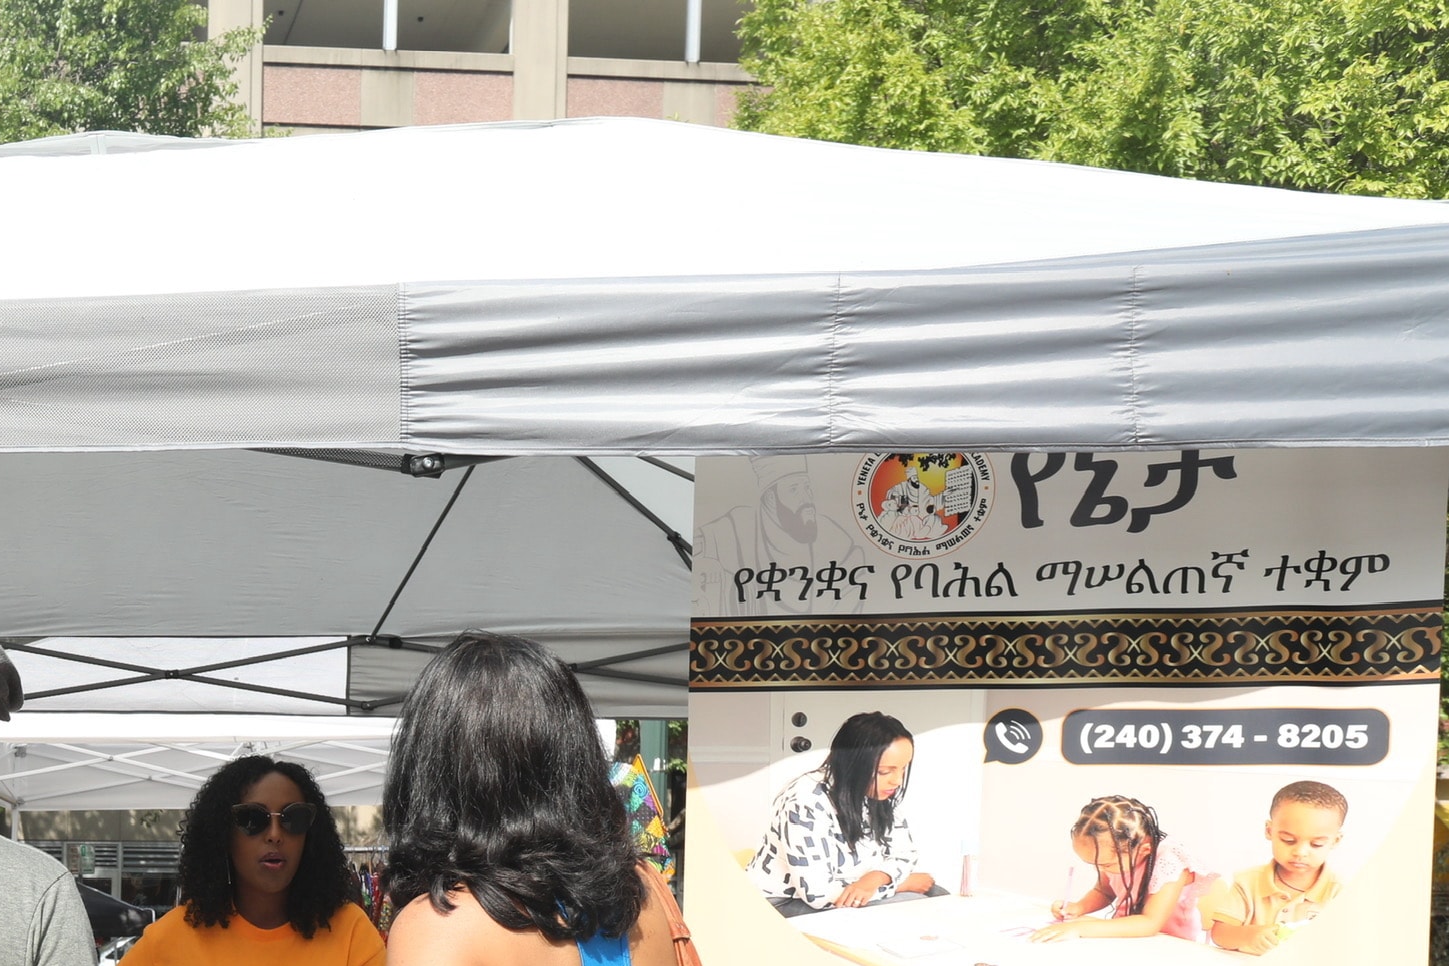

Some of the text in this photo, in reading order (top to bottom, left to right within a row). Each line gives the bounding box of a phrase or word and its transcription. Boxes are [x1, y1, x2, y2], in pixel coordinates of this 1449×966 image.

[857, 457, 876, 486] YENETA
[1010, 449, 1238, 534] የኔታ
[734, 549, 1390, 602] የቋንቋና የባሕል ማሠልጠኛ ተቋም
[1080, 723, 1173, 754] (240)
[1181, 724, 1245, 749] 374
[1277, 724, 1368, 749] 8205
